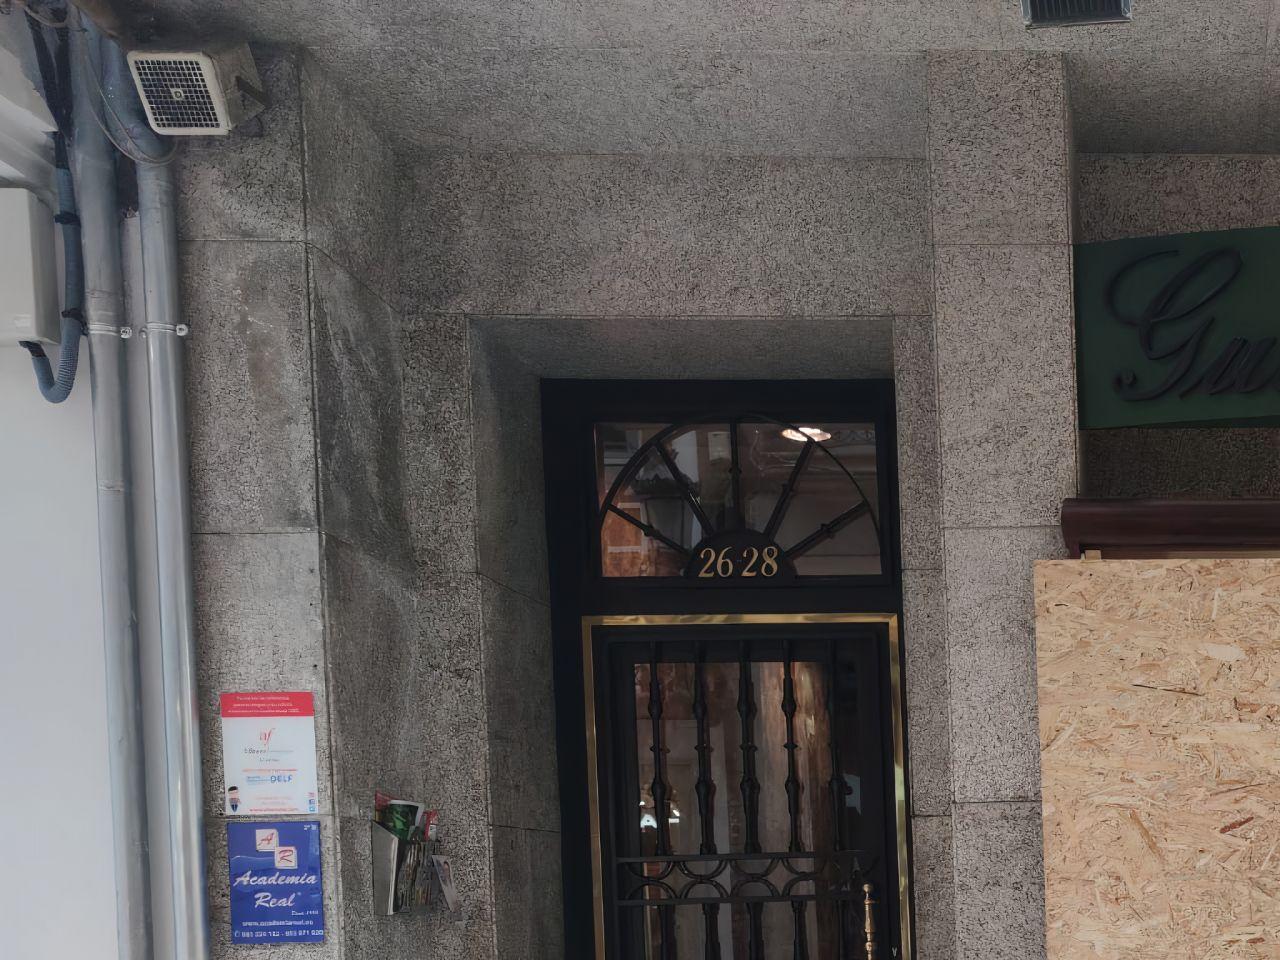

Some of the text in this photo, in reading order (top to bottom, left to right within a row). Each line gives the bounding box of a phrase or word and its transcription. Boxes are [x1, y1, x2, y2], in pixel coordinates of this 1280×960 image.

[697, 546, 778, 578] 26 28
[233, 870, 318, 887] Academia
[254, 891, 297, 909] Real
